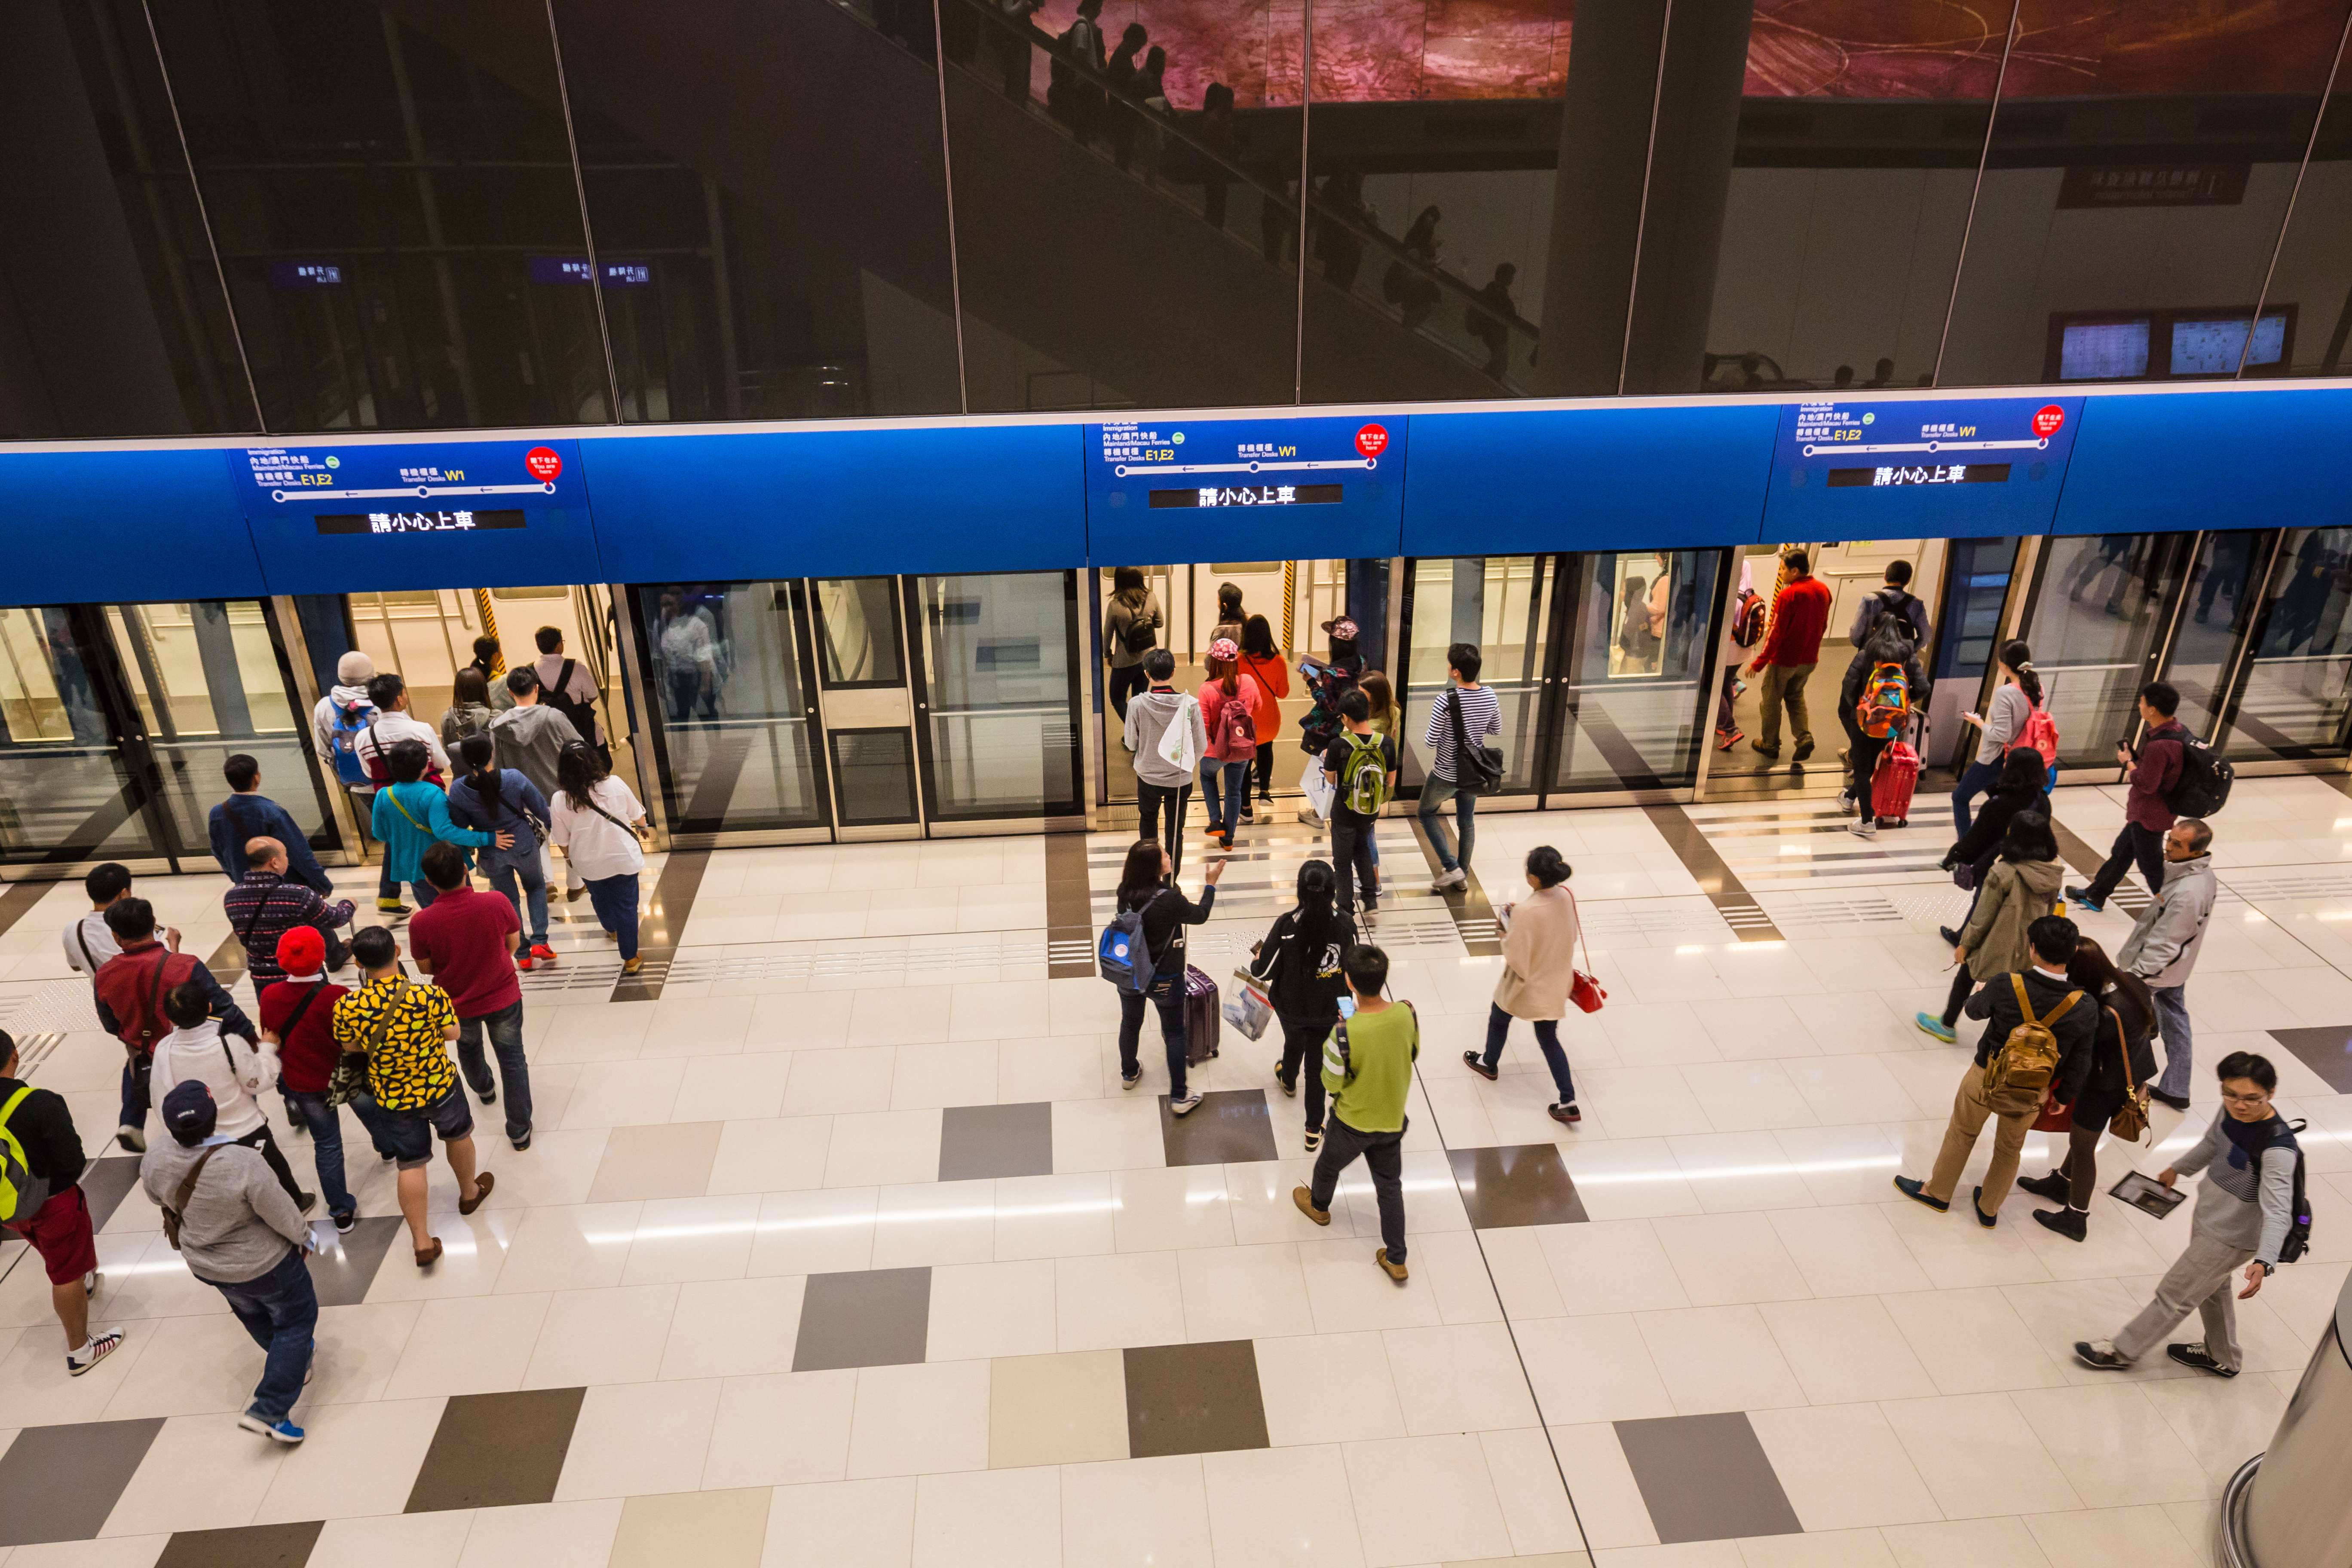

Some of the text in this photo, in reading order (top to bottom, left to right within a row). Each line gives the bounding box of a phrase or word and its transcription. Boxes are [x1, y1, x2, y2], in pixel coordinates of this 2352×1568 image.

[1960, 426, 1976, 437] W1
[1279, 446, 1296, 456] W1
[444, 470, 465, 481] W1
[1873, 465, 1966, 486] 請小心上車
[1199, 485, 1295, 507] 請小心上車
[369, 510, 476, 533] 請小心上車
